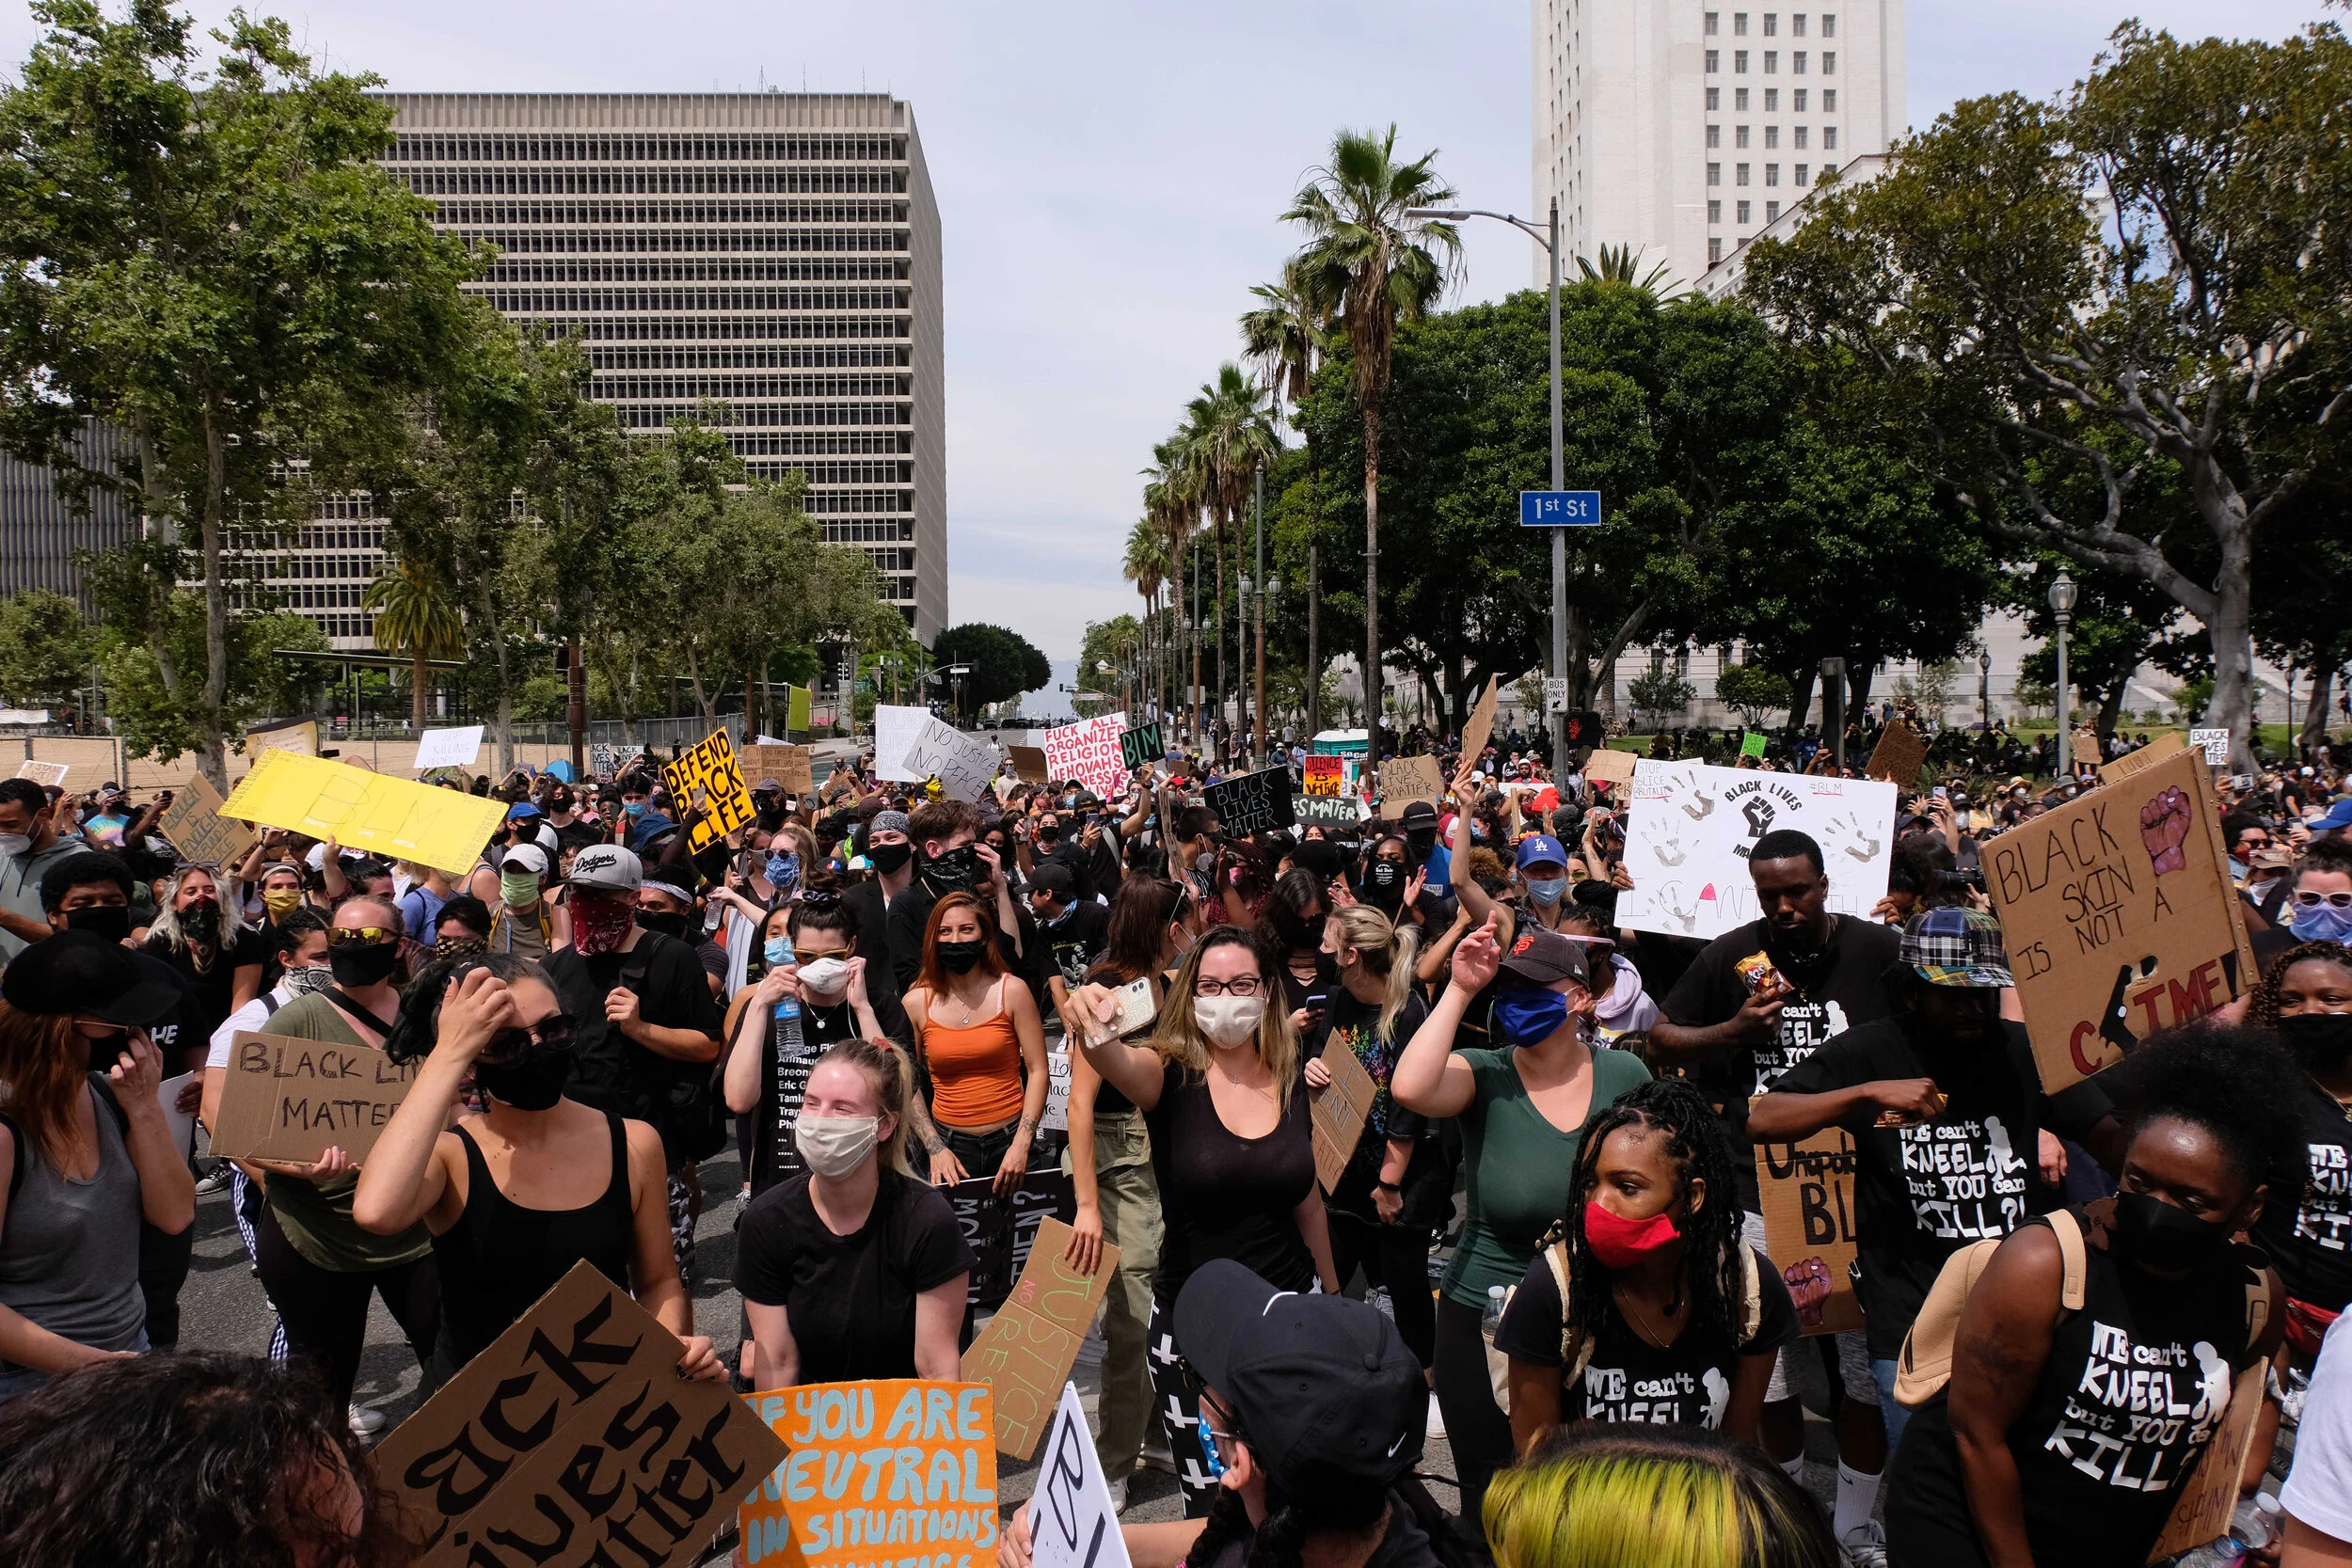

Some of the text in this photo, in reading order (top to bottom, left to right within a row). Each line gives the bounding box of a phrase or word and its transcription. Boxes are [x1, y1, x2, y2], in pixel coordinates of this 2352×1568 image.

[1566, 499, 1587, 517] St
[1549, 680, 1564, 689] BUS
[1045, 717, 1121, 743] FUCK ALL
[1046, 725, 1129, 755] ORGANIZED
[2192, 730, 2228, 741] BLACK
[925, 721, 997, 776] NO JUSTICE
[1048, 742, 1125, 771] RELIGION
[1125, 724, 1167, 768] BLM
[2205, 741, 2226, 752] VES
[664, 731, 731, 794] DEFEND
[913, 746, 987, 800] NO PEACE
[1306, 756, 1340, 771] SILENCE
[1379, 760, 1421, 777] BLACK
[1639, 762, 1661, 774] STOP
[1215, 772, 1273, 806] BLACK
[1381, 773, 1424, 790] LIVES
[1384, 783, 1436, 804] MATTER
[1635, 775, 1665, 786] POLICE
[1808, 783, 1842, 795] #BLM
[1223, 792, 1270, 819] LIVES
[1724, 780, 1803, 812] BLACK LIVES
[1219, 807, 1279, 837] MATTER
[1310, 799, 1356, 820] MATTER
[1535, 838, 1549, 852] LA
[1996, 802, 2119, 905] BLACK
[574, 854, 617, 873] Dodgers
[2063, 855, 2136, 923] SKIN
[2017, 886, 2172, 980] IS NOT A
[149, 1024, 179, 1044] HE
[239, 1042, 363, 1079] BLACK
[1752, 1050, 1779, 1065] but
[777, 1067, 813, 1076] Breon
[779, 1080, 797, 1089] Eric
[1935, 1120, 1981, 1139] can't
[1900, 1141, 1985, 1174] KNEEL
[1906, 1174, 2026, 1200] but YOU can
[2090, 1321, 2187, 1368] WE can't
[1584, 1364, 1695, 1401] WE can't
[2077, 1355, 2190, 1417] KNEEL
[792, 1387, 875, 1444] YOU
[884, 1386, 989, 1441] ARE
[2064, 1395, 2116, 1431] but
[2122, 1415, 2185, 1447] YOU
[747, 1508, 997, 1565] IN SITUATIONS
